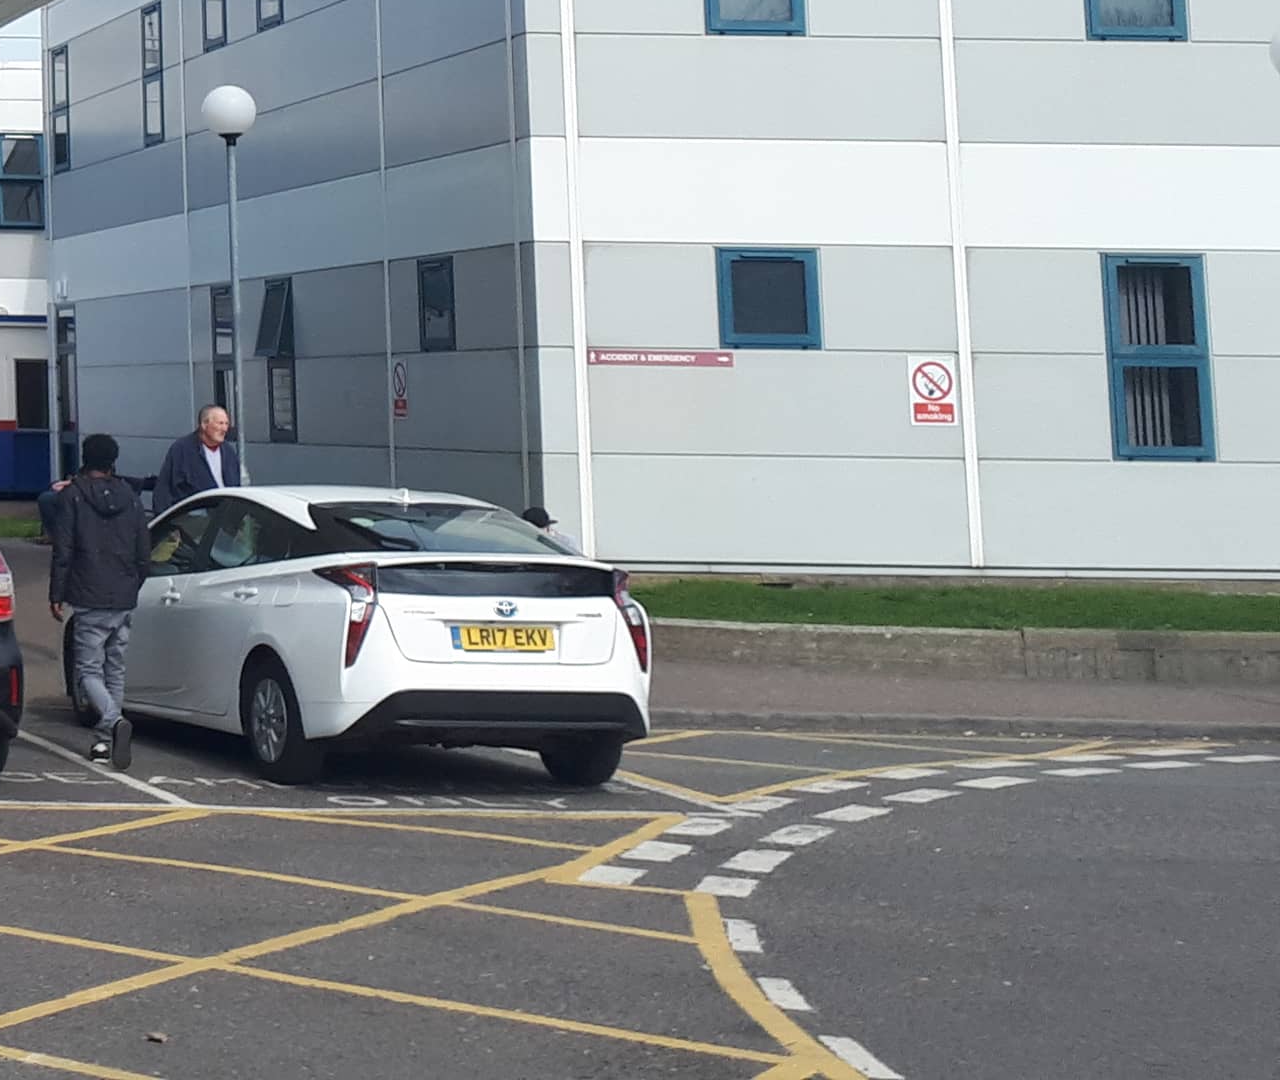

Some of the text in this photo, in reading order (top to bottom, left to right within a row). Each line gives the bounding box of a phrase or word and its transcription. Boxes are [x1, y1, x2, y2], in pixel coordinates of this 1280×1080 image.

[600, 352, 638, 361] ACCIDENT
[647, 354, 697, 363] EMERGENCY
[927, 403, 940, 412] No
[916, 413, 953, 422] smoking
[467, 628, 547, 647] LR17 EKV
[326, 795, 568, 809] ONLY
